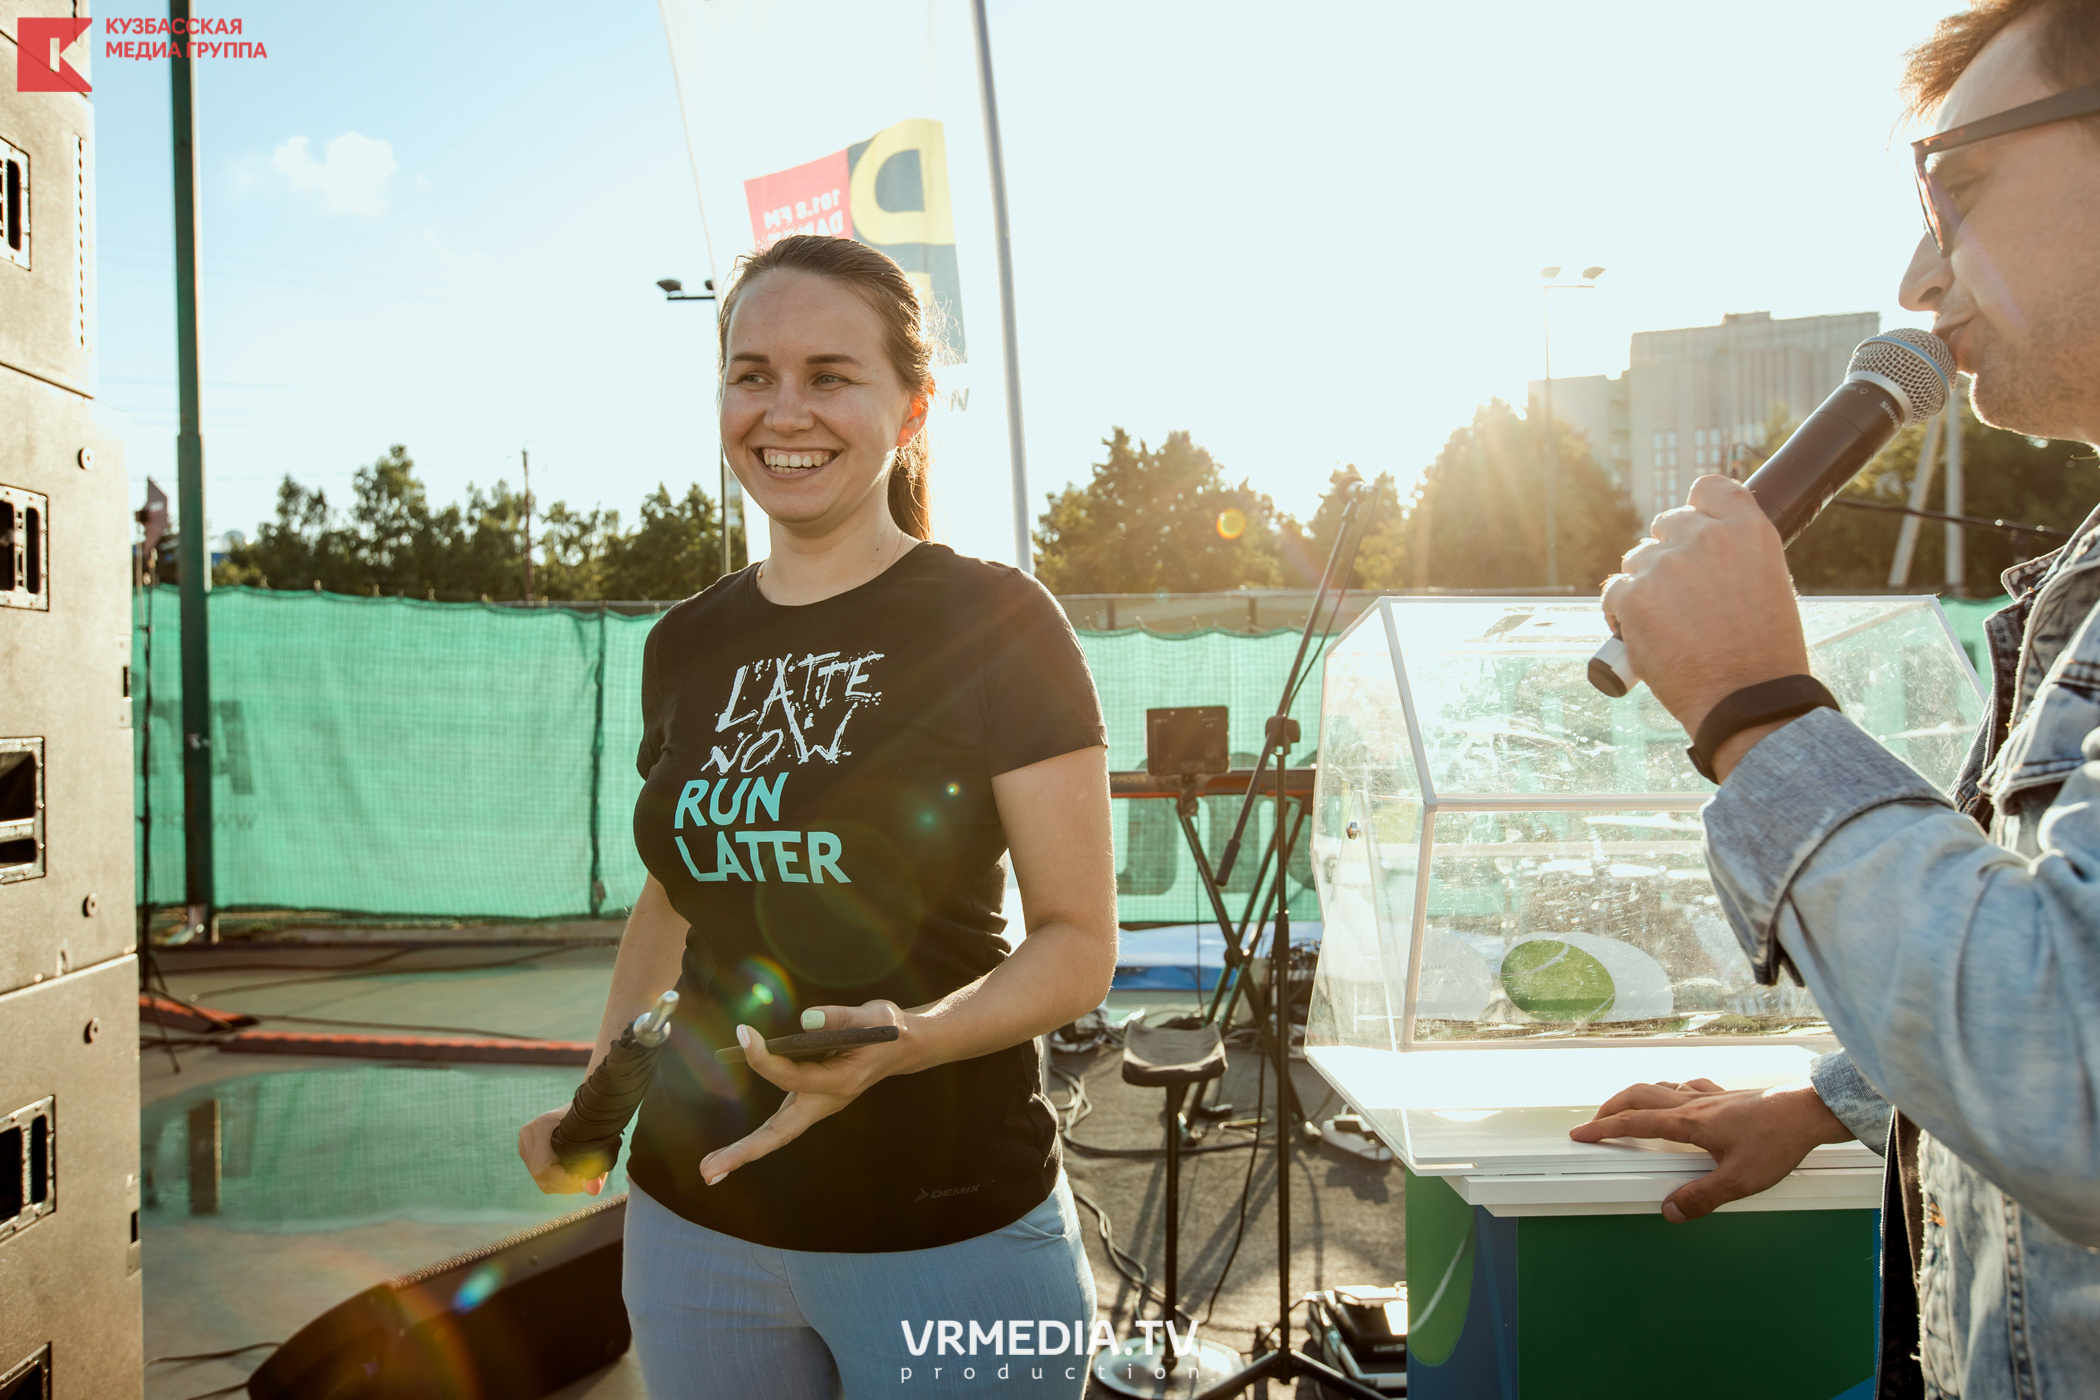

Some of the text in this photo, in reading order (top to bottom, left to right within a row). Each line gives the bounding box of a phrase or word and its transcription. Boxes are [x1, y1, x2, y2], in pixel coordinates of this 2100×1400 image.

[674, 772, 790, 829] RUN
[674, 831, 852, 884] LATER
[930, 1183, 981, 1199] DEMIX
